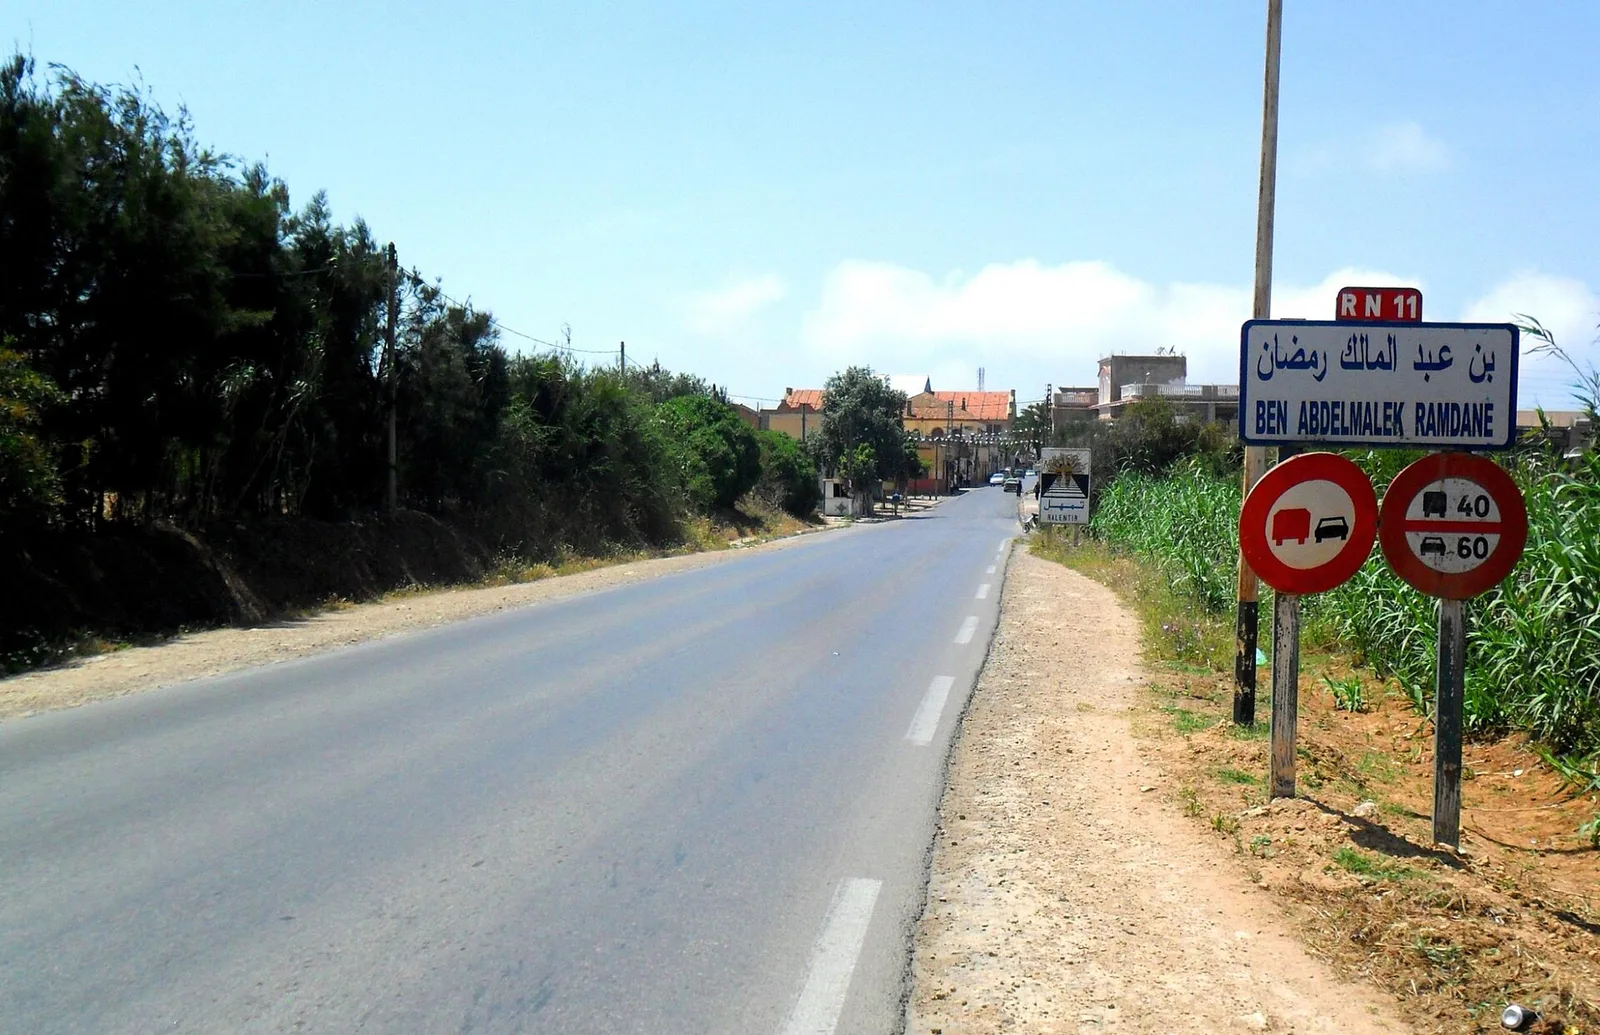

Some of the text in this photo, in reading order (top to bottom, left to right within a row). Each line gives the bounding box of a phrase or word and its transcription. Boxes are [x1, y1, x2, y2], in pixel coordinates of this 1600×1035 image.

[1393, 294, 1418, 318] 11
[1257, 333, 1496, 383] بن عبد المالك رمضان
[1256, 400, 1494, 437] BEN ABDELMALEK RAMDANE
[1457, 494, 1490, 518] 40
[1457, 536, 1489, 560] 60
